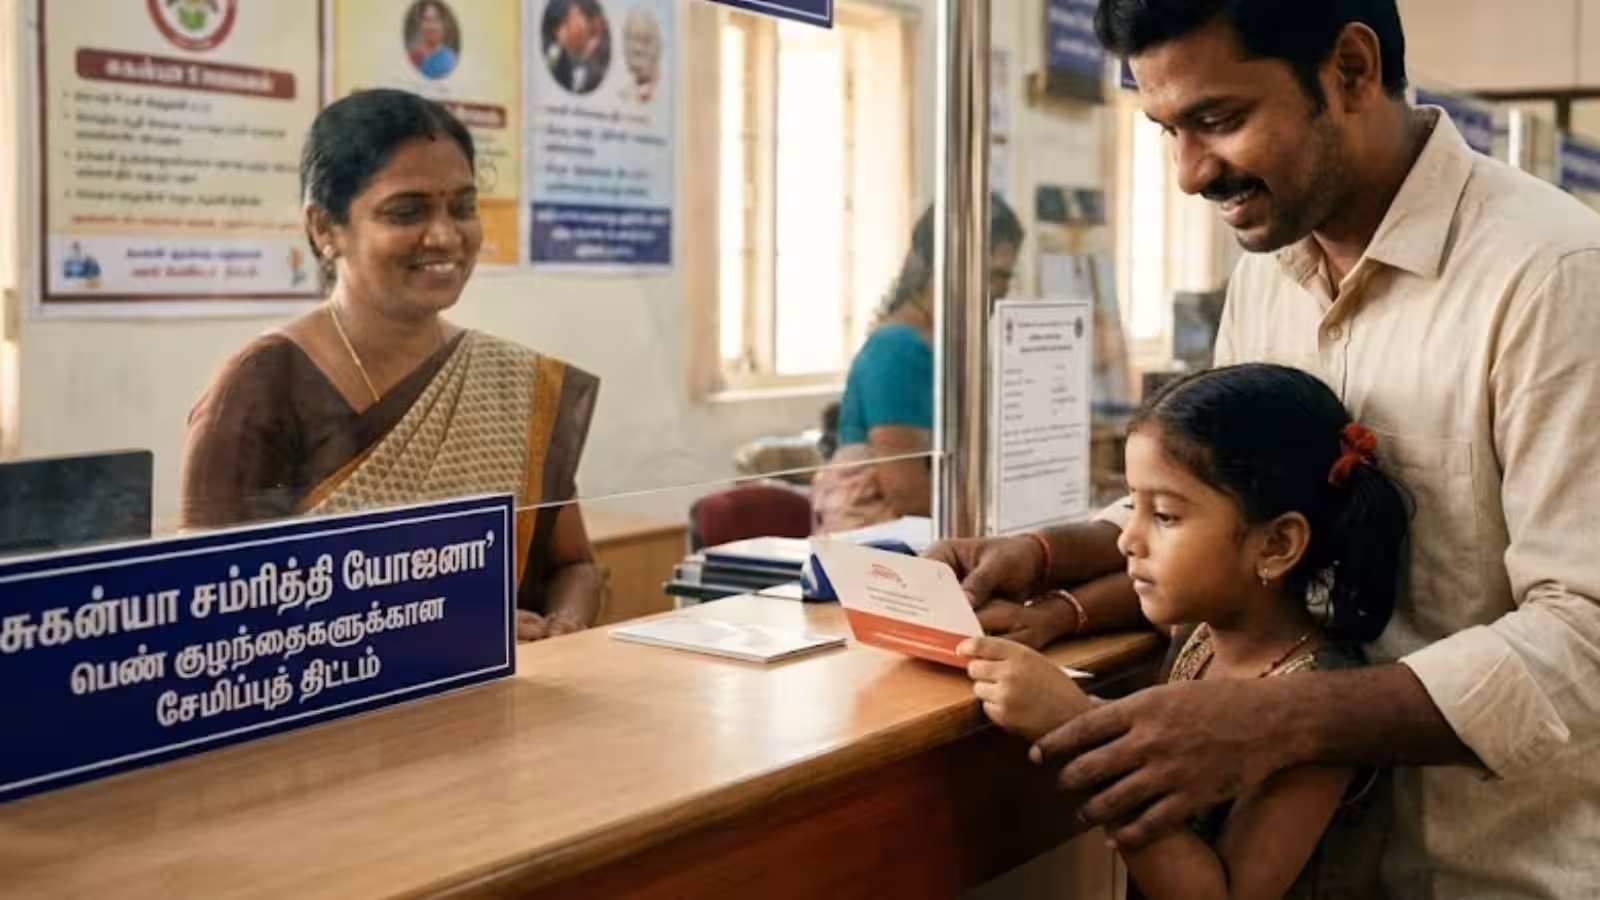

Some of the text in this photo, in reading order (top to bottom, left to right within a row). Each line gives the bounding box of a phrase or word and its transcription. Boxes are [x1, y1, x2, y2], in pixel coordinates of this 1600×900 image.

[0, 585, 181, 653] சுகன்யா
[190, 554, 333, 618] சம்ரித்தி
[70, 598, 446, 695] பெண் குழந்தைகளுக்கான
[156, 646, 381, 727] சேமிப்புத் திட்டம்
